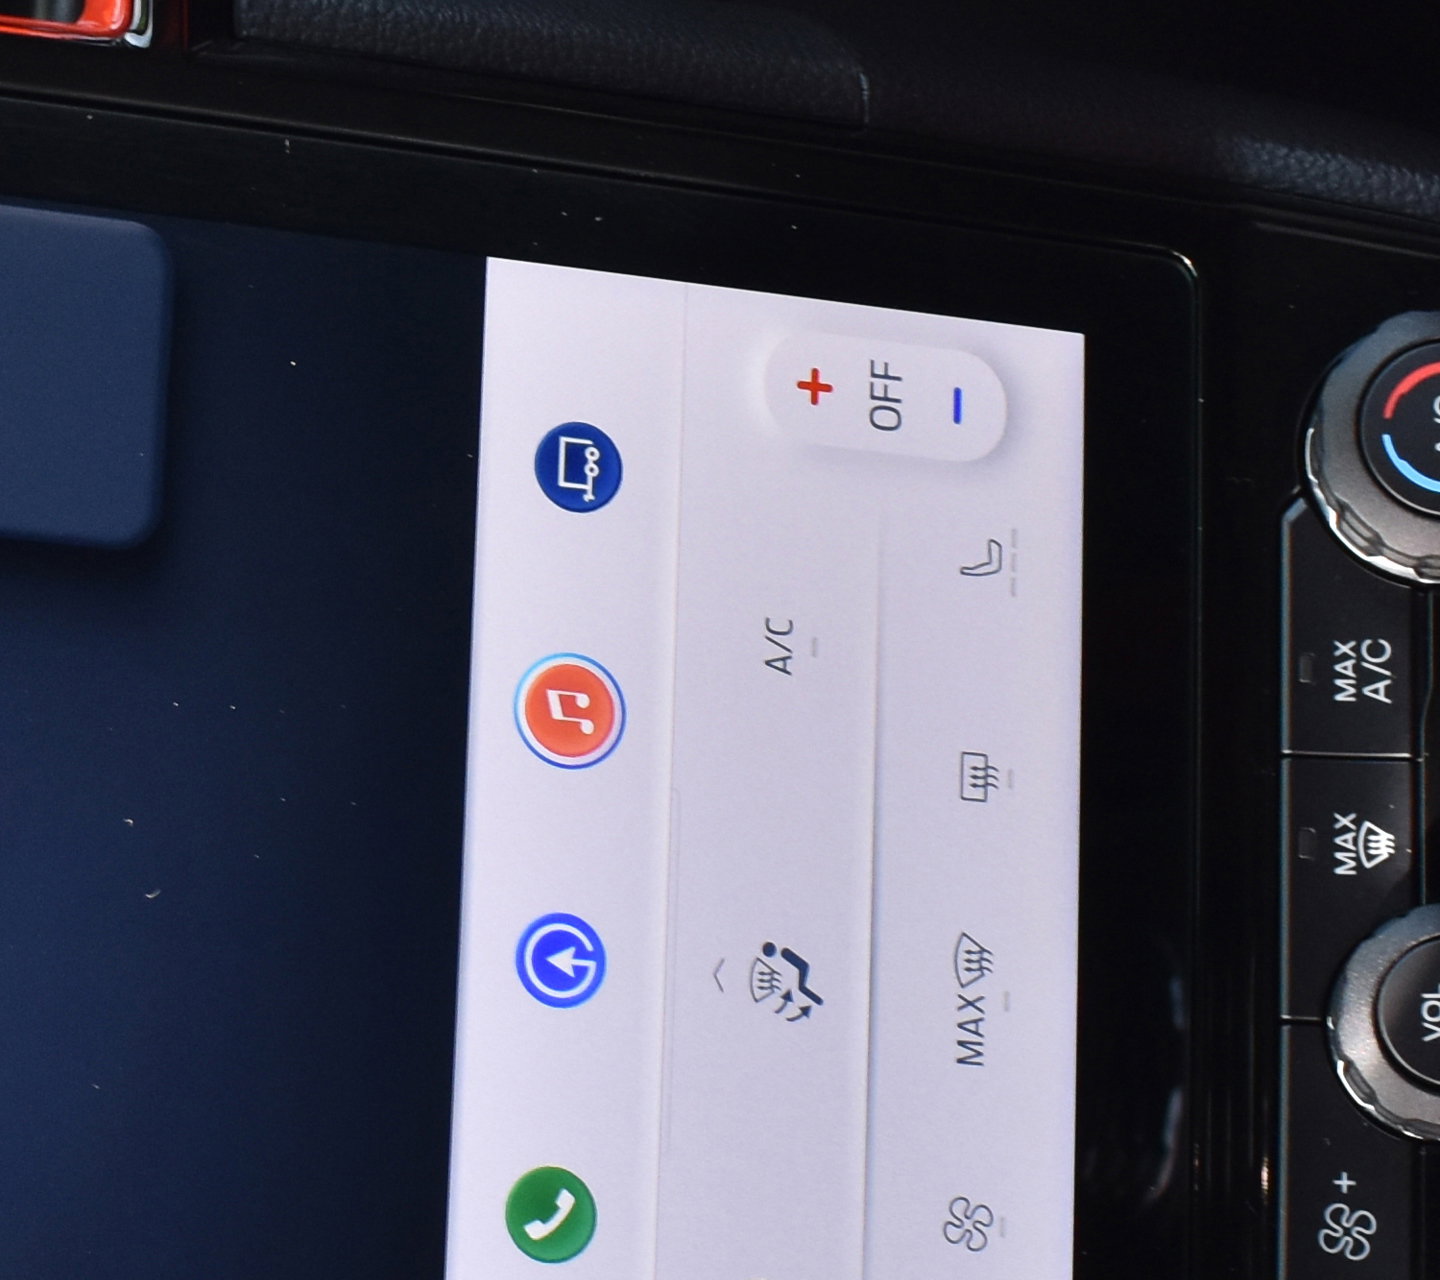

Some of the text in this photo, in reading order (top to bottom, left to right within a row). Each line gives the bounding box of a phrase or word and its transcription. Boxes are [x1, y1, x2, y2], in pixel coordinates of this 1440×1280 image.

[869, 359, 903, 432] OFF
[764, 616, 794, 676] A/C
[1333, 639, 1358, 702] MAX
[1361, 638, 1393, 704] A/C
[1333, 812, 1358, 876] MAX
[956, 993, 987, 1067] MAX
